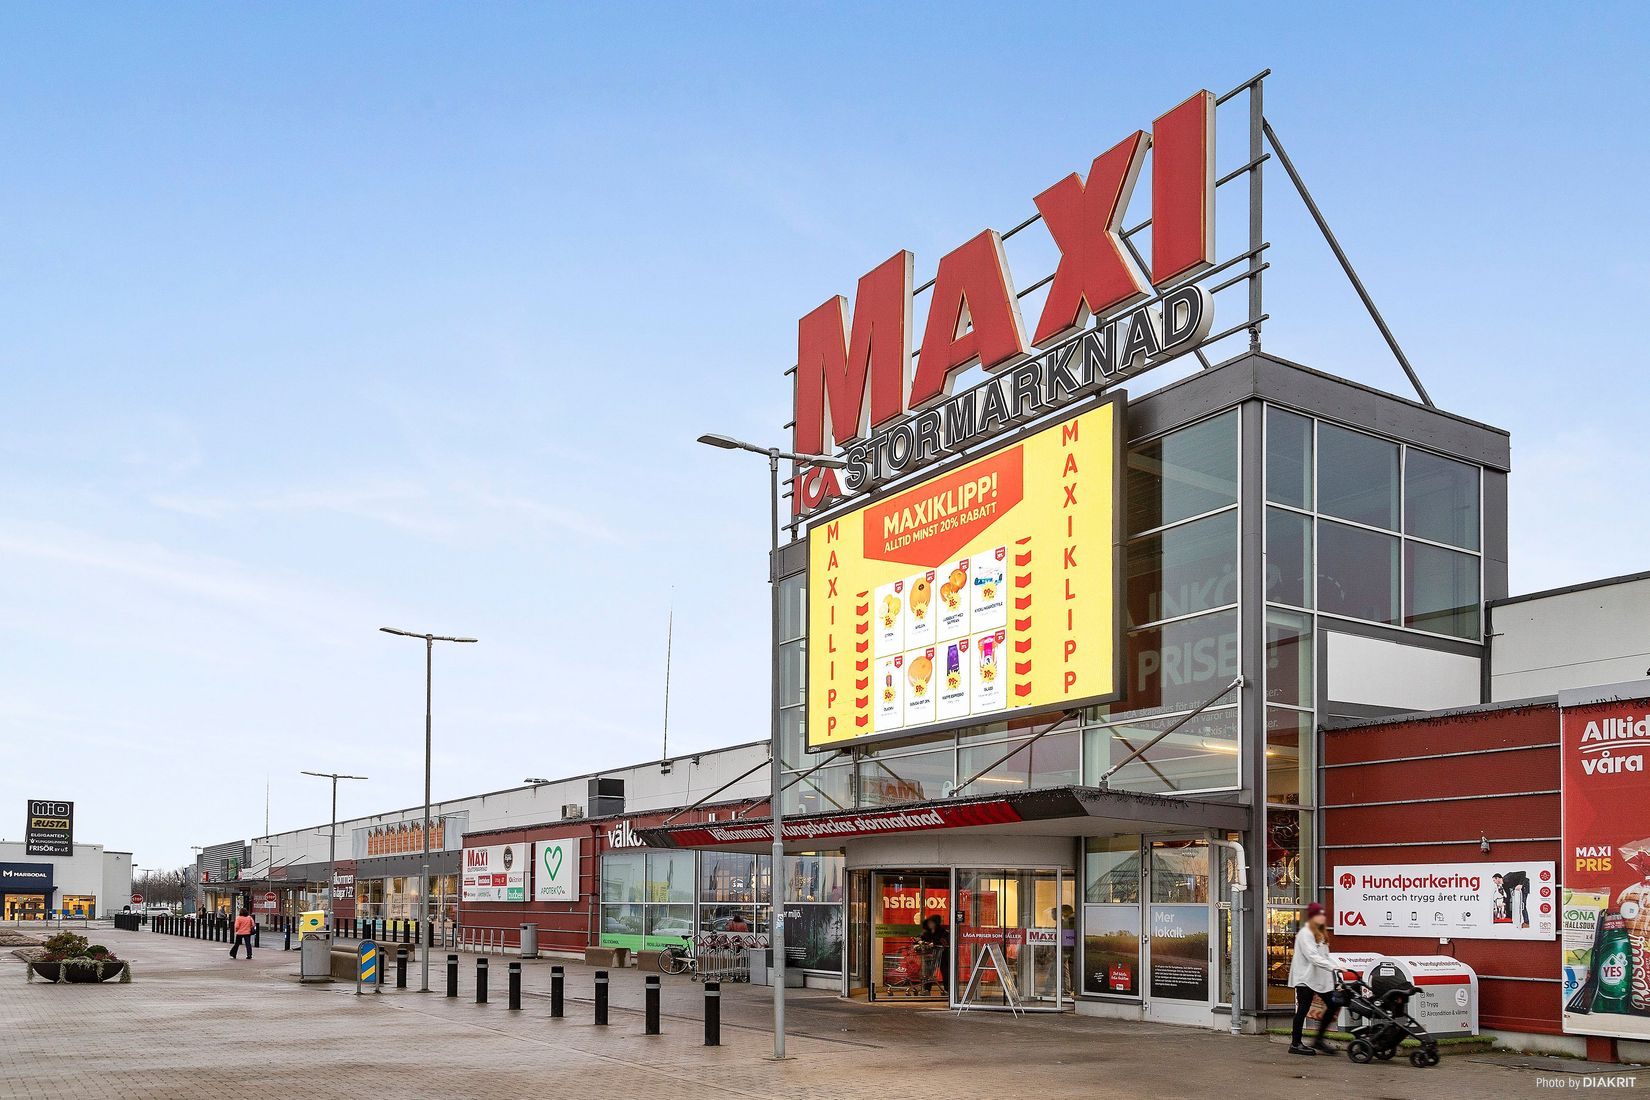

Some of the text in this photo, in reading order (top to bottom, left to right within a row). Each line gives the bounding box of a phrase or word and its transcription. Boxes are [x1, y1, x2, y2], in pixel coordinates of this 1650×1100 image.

[796, 89, 1214, 465] MAXI
[794, 284, 1208, 516] ICA STORMARKNAD
[884, 472, 997, 539] MAXIKLIPP!
[884, 502, 997, 553] ALLTID MINST 20% RABATT
[1062, 420, 1079, 693] MAXIKLIPP
[1581, 750, 1643, 776] våra
[33, 819, 67, 828] RUSTA
[708, 825, 769, 843] Välkommen
[855, 810, 945, 832] stormarknad
[29, 844, 54, 852] FRISÖR
[1576, 846, 1611, 857] MAXI
[467, 850, 488, 866] MAXI
[1576, 858, 1612, 871] PRIS
[1362, 873, 1481, 892] Hundparkering
[1362, 893, 1480, 903] Smart och trygg året runt
[1155, 912, 1175, 923] Mer
[1339, 911, 1367, 926] ICA
[1155, 925, 1186, 939] lokalt.
[1603, 966, 1622, 978] YES
